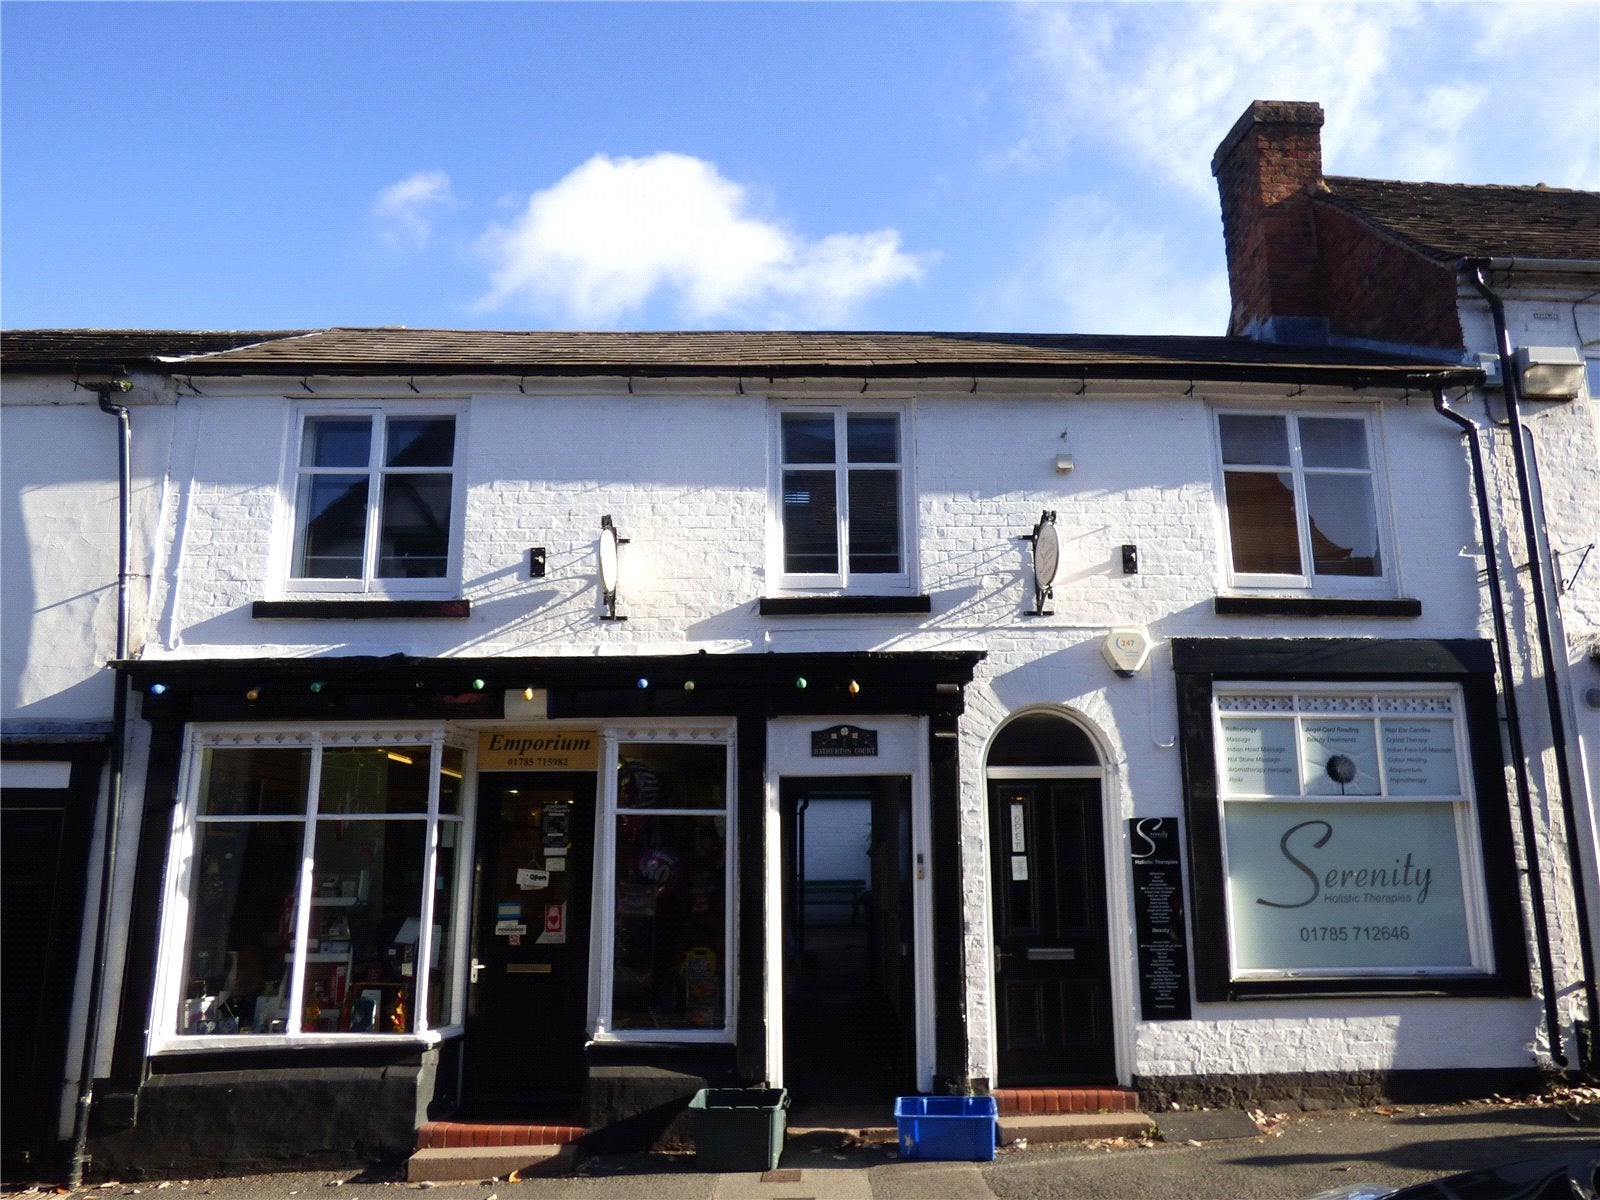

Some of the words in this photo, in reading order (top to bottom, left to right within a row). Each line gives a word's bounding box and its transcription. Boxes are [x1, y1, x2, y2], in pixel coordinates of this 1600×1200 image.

[1121, 639, 1135, 647] 247
[488, 734, 591, 756] Emporium
[814, 747, 852, 755] HATHERTON
[853, 747, 875, 755] COURT
[507, 758, 534, 766] 01785
[537, 757, 569, 767] 715982
[1228, 766, 1266, 774] Aromatherapy
[1256, 820, 1433, 909] Serenity
[529, 873, 547, 881] Open
[1324, 892, 1360, 904] Holistic
[1363, 892, 1412, 905] Therapies
[1300, 926, 1348, 942] 01785
[1352, 925, 1410, 942] 712646
